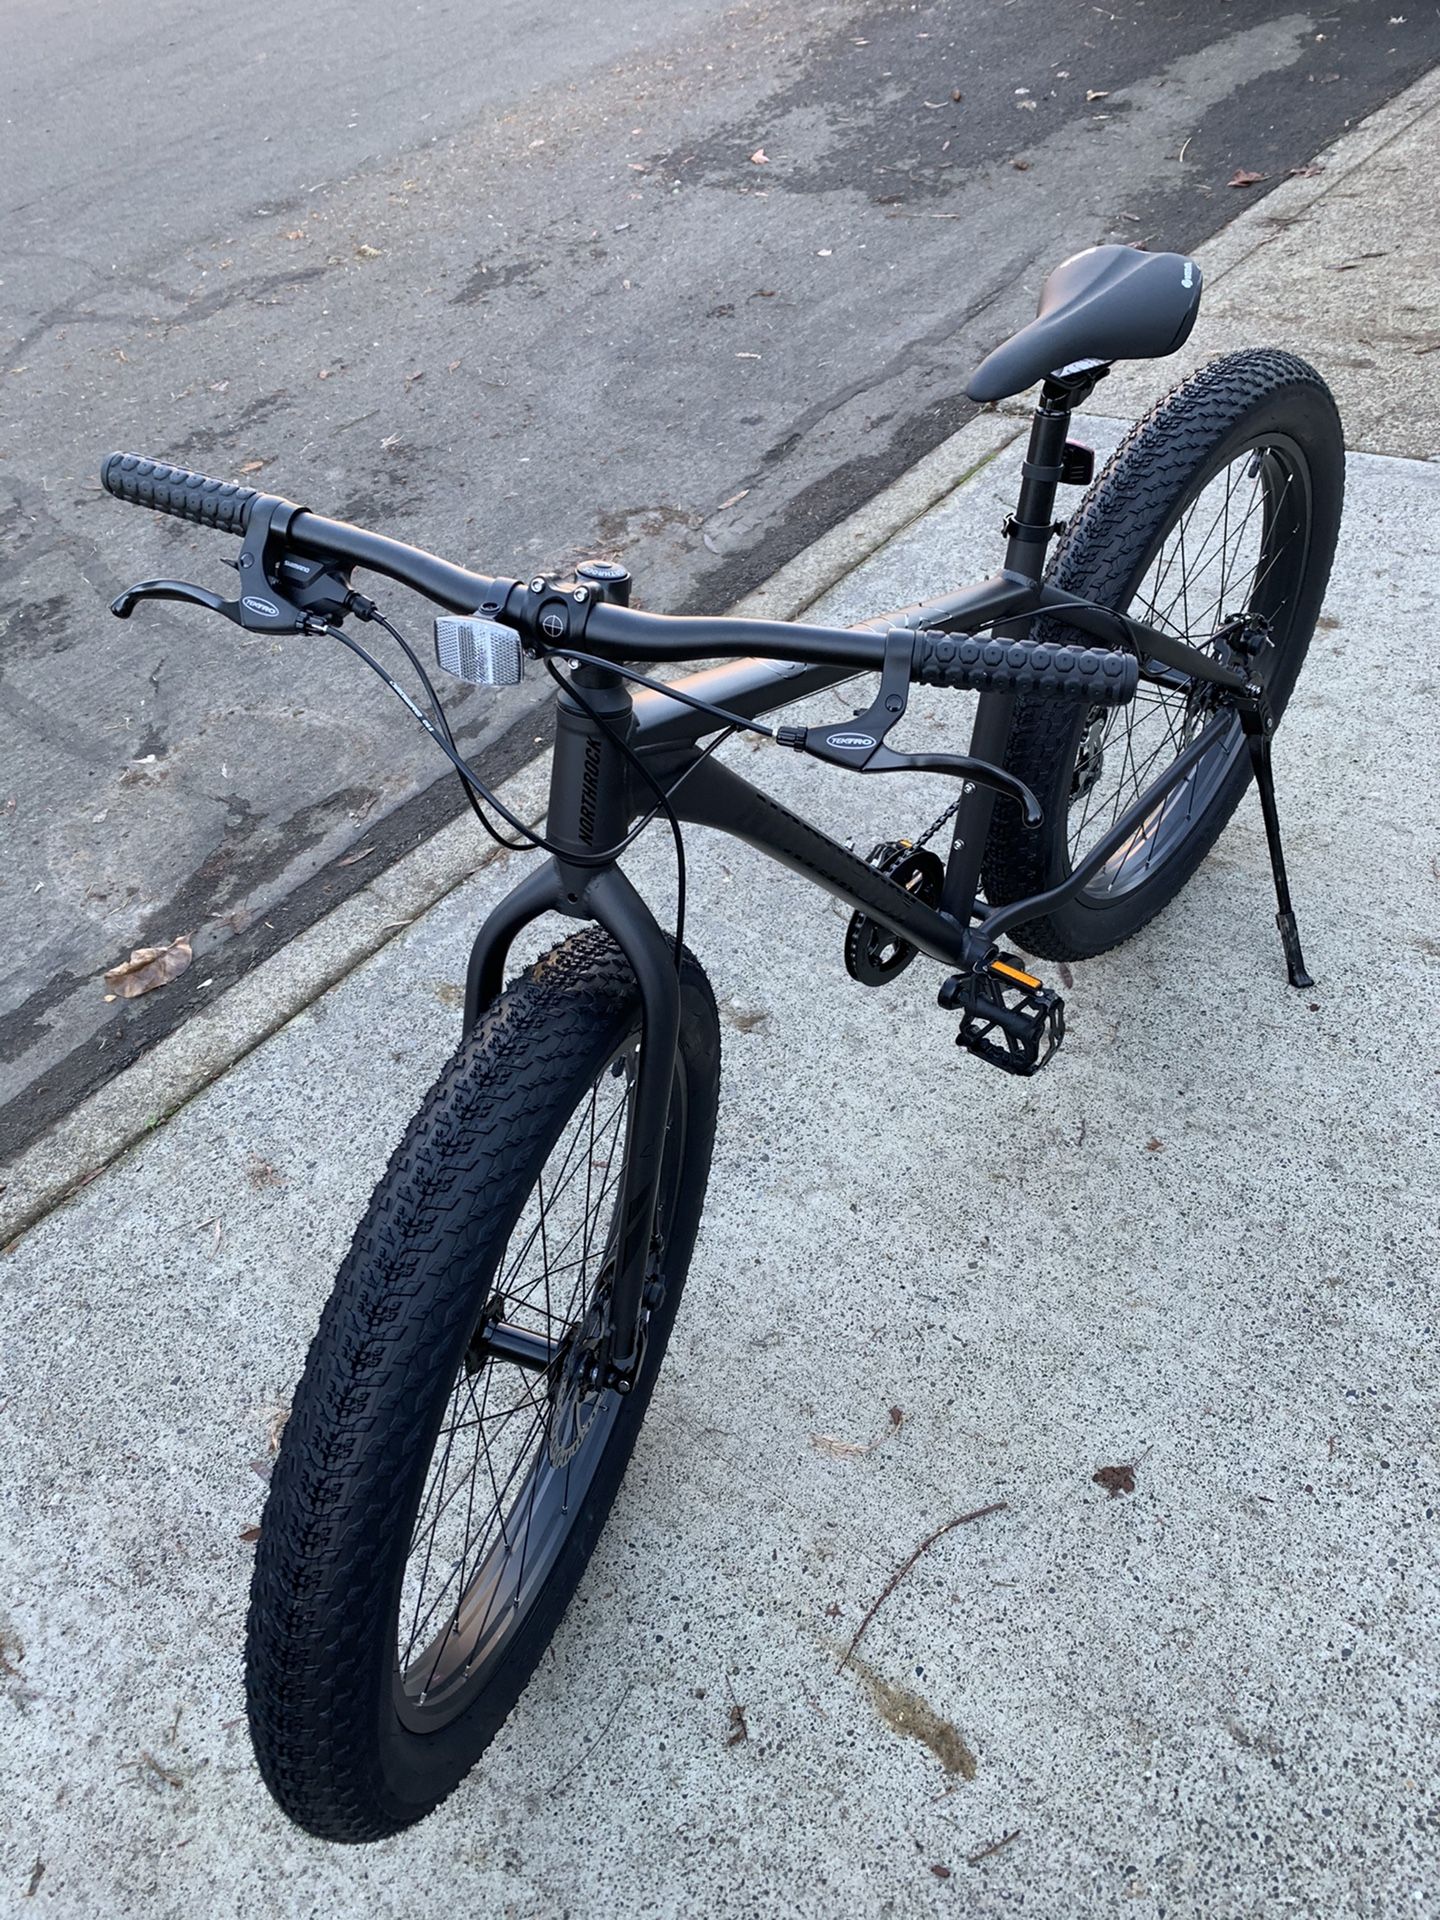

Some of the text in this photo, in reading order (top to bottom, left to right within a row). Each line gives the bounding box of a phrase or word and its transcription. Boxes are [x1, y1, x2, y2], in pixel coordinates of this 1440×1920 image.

[245, 599, 276, 615] TEKTRO
[831, 737, 873, 745] TEKTRO
[579, 735, 602, 847] NORTHROCK
